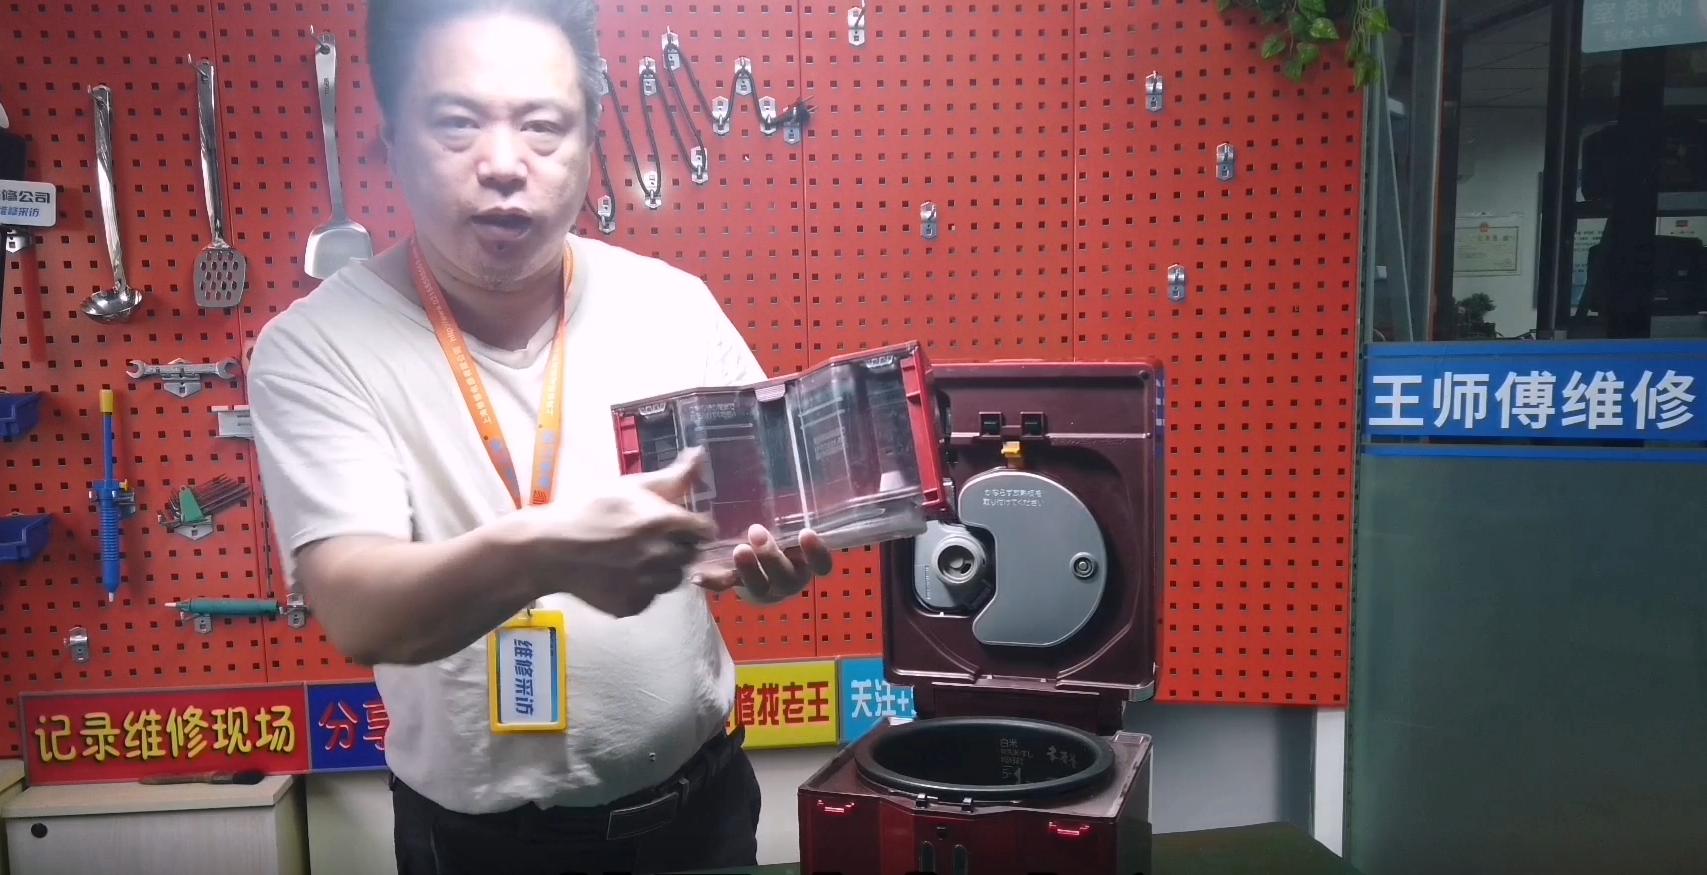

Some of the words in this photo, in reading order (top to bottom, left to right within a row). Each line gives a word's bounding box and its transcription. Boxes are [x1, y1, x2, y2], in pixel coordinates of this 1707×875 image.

[1368, 369, 1697, 430] 王师傅维修
[514, 638, 534, 716] 维修采访
[728, 681, 830, 727] 修找老王
[34, 705, 296, 762] 记录维修现场
